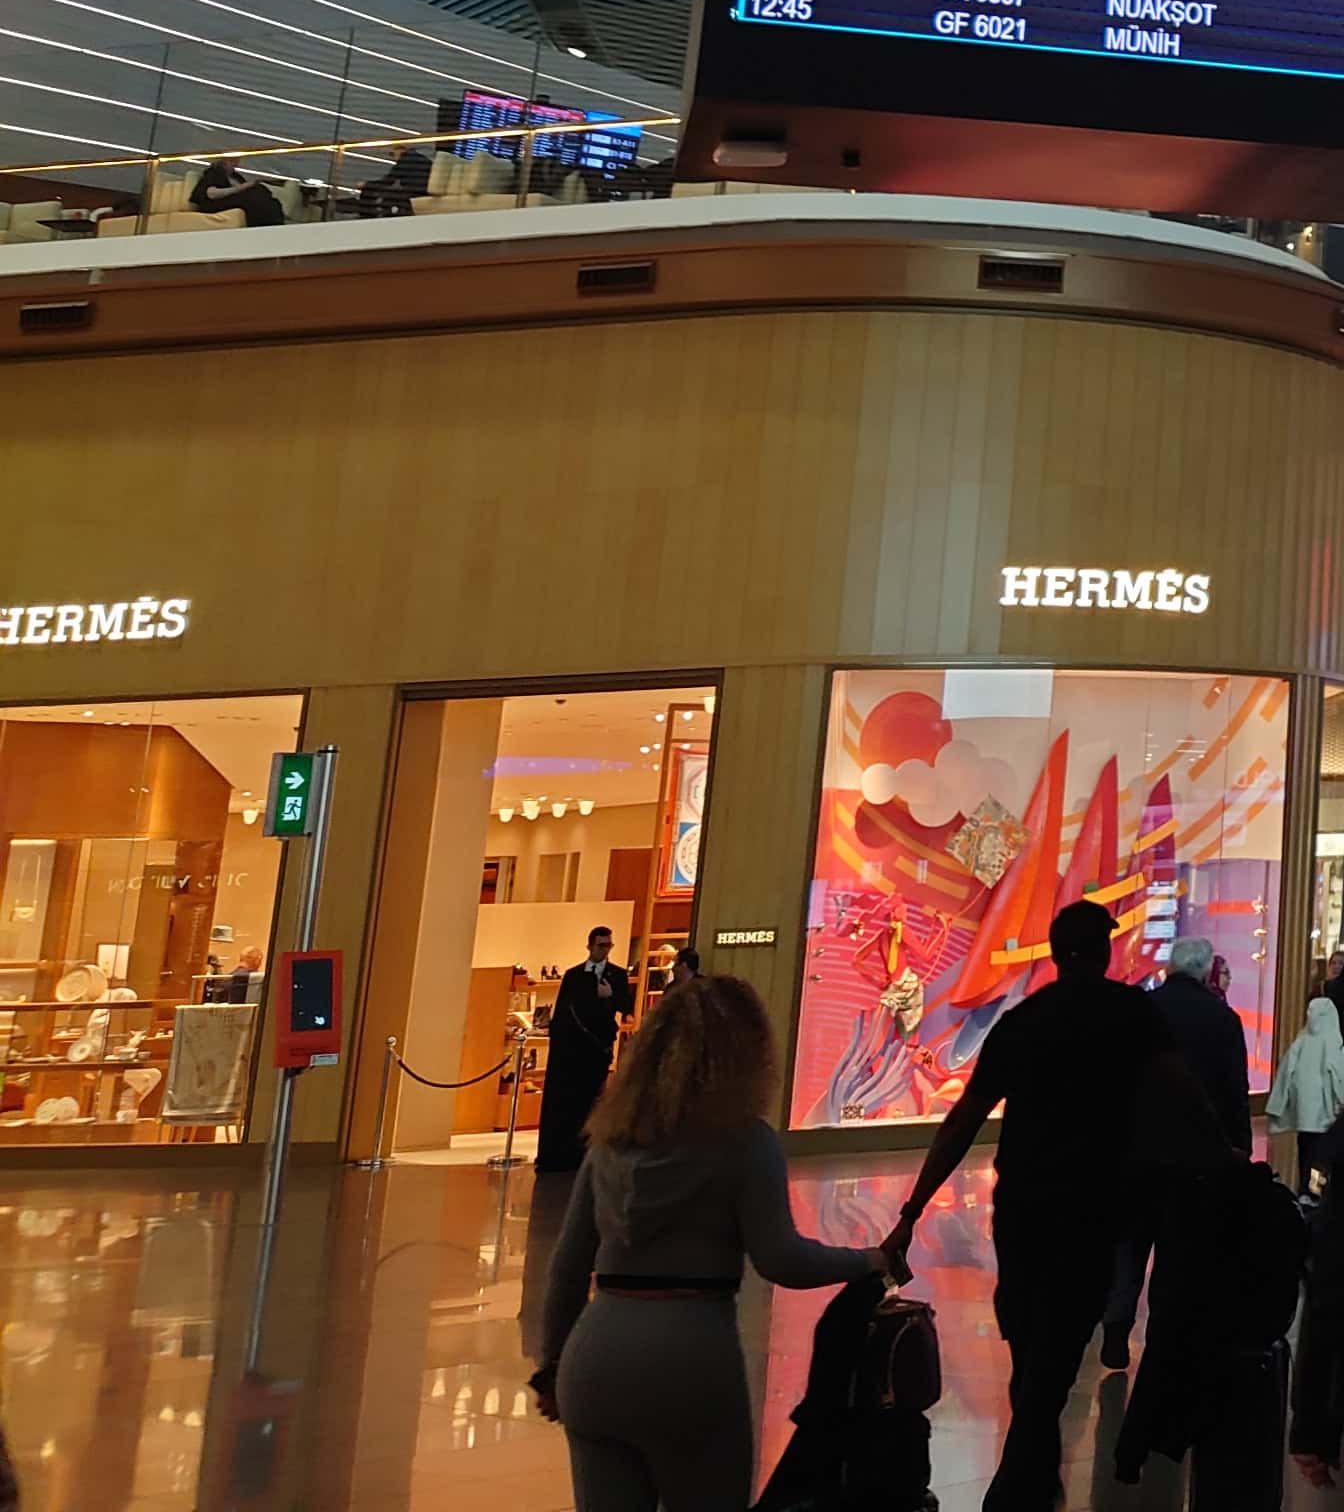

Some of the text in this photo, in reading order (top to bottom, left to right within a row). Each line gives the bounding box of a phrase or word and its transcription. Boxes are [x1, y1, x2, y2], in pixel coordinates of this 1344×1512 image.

[935, 10, 969, 34] GF
[974, 14, 1025, 41] 6021
[1105, 24, 1179, 56] MÜNİH
